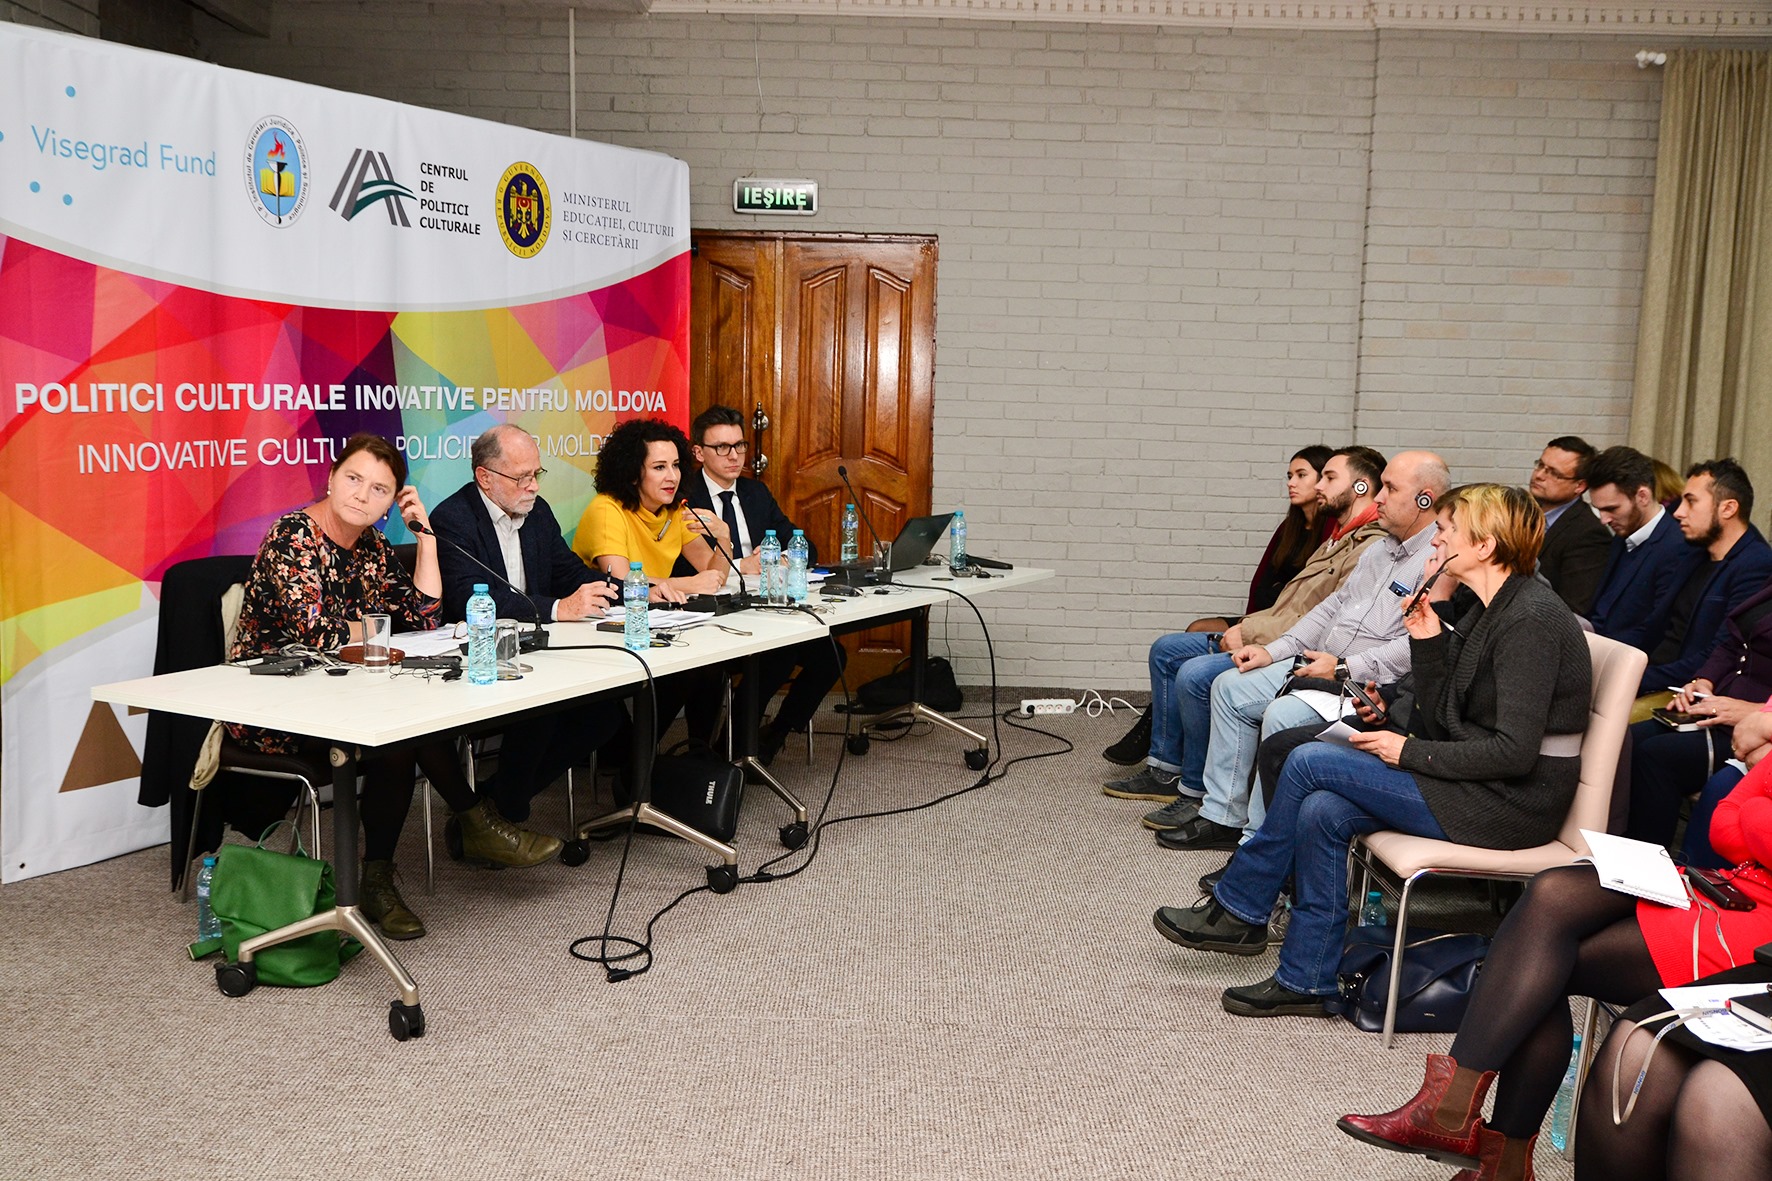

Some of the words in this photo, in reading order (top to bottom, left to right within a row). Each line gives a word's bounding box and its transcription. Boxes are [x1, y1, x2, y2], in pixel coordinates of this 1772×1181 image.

[30, 124, 148, 171] Visegrad
[160, 144, 216, 178] Fund
[420, 162, 468, 181] CENTRUL
[420, 180, 434, 193] DE
[420, 198, 469, 216] POLITICI
[563, 192, 631, 213] MINISTERUL
[420, 216, 480, 235] CULTURALE
[628, 220, 674, 237] CULTURII
[575, 231, 639, 250] CERCETĂRII
[15, 382, 164, 414] POLITICI
[175, 382, 346, 412] CULTURALE
[355, 384, 474, 412] INOVATIVE
[483, 387, 568, 412] PENTRU
[576, 389, 667, 412] MOLDOVA
[78, 438, 247, 474] INNOVATIVE
[258, 436, 350, 466] CULTU
[547, 433, 613, 458] MOLD
[706, 780, 716, 805] THULE
